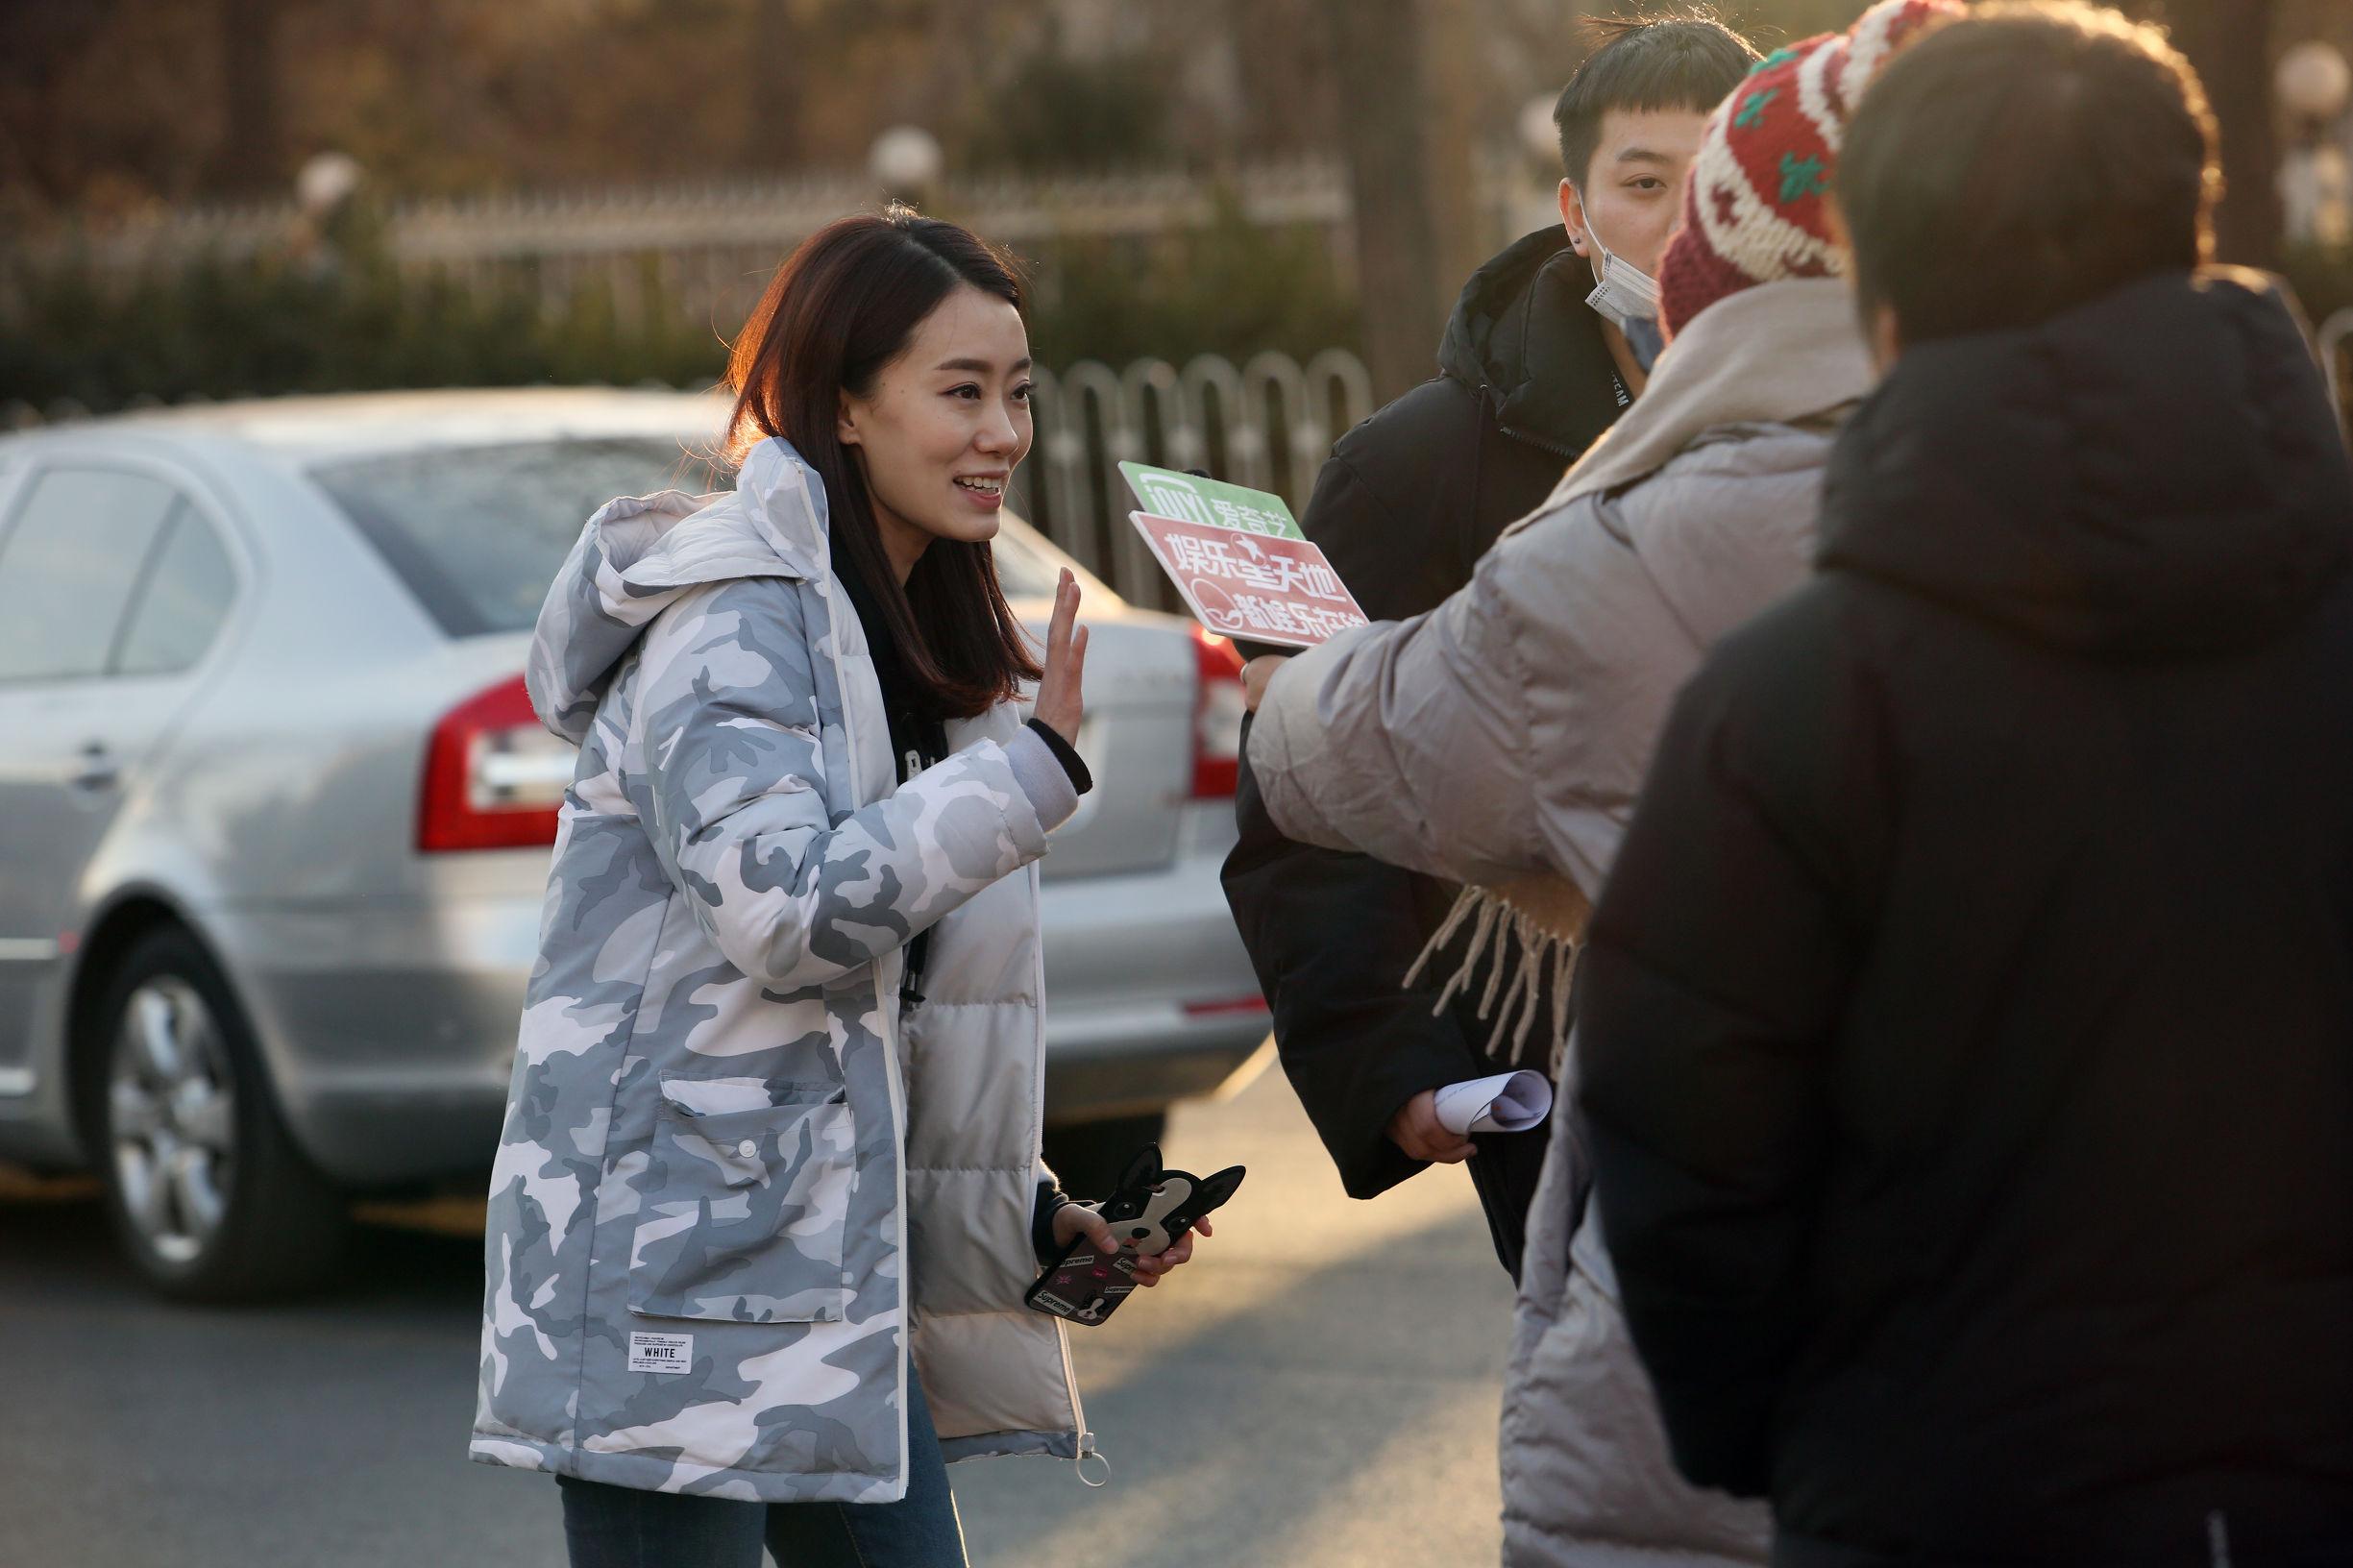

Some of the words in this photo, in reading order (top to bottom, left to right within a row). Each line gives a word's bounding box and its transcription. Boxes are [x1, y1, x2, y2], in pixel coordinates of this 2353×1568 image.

[1061, 1256, 1093, 1266] upreme
[1116, 1259, 1134, 1273] Supr
[1038, 1290, 1071, 1313] Supreme
[645, 1347, 675, 1359] WHITE
